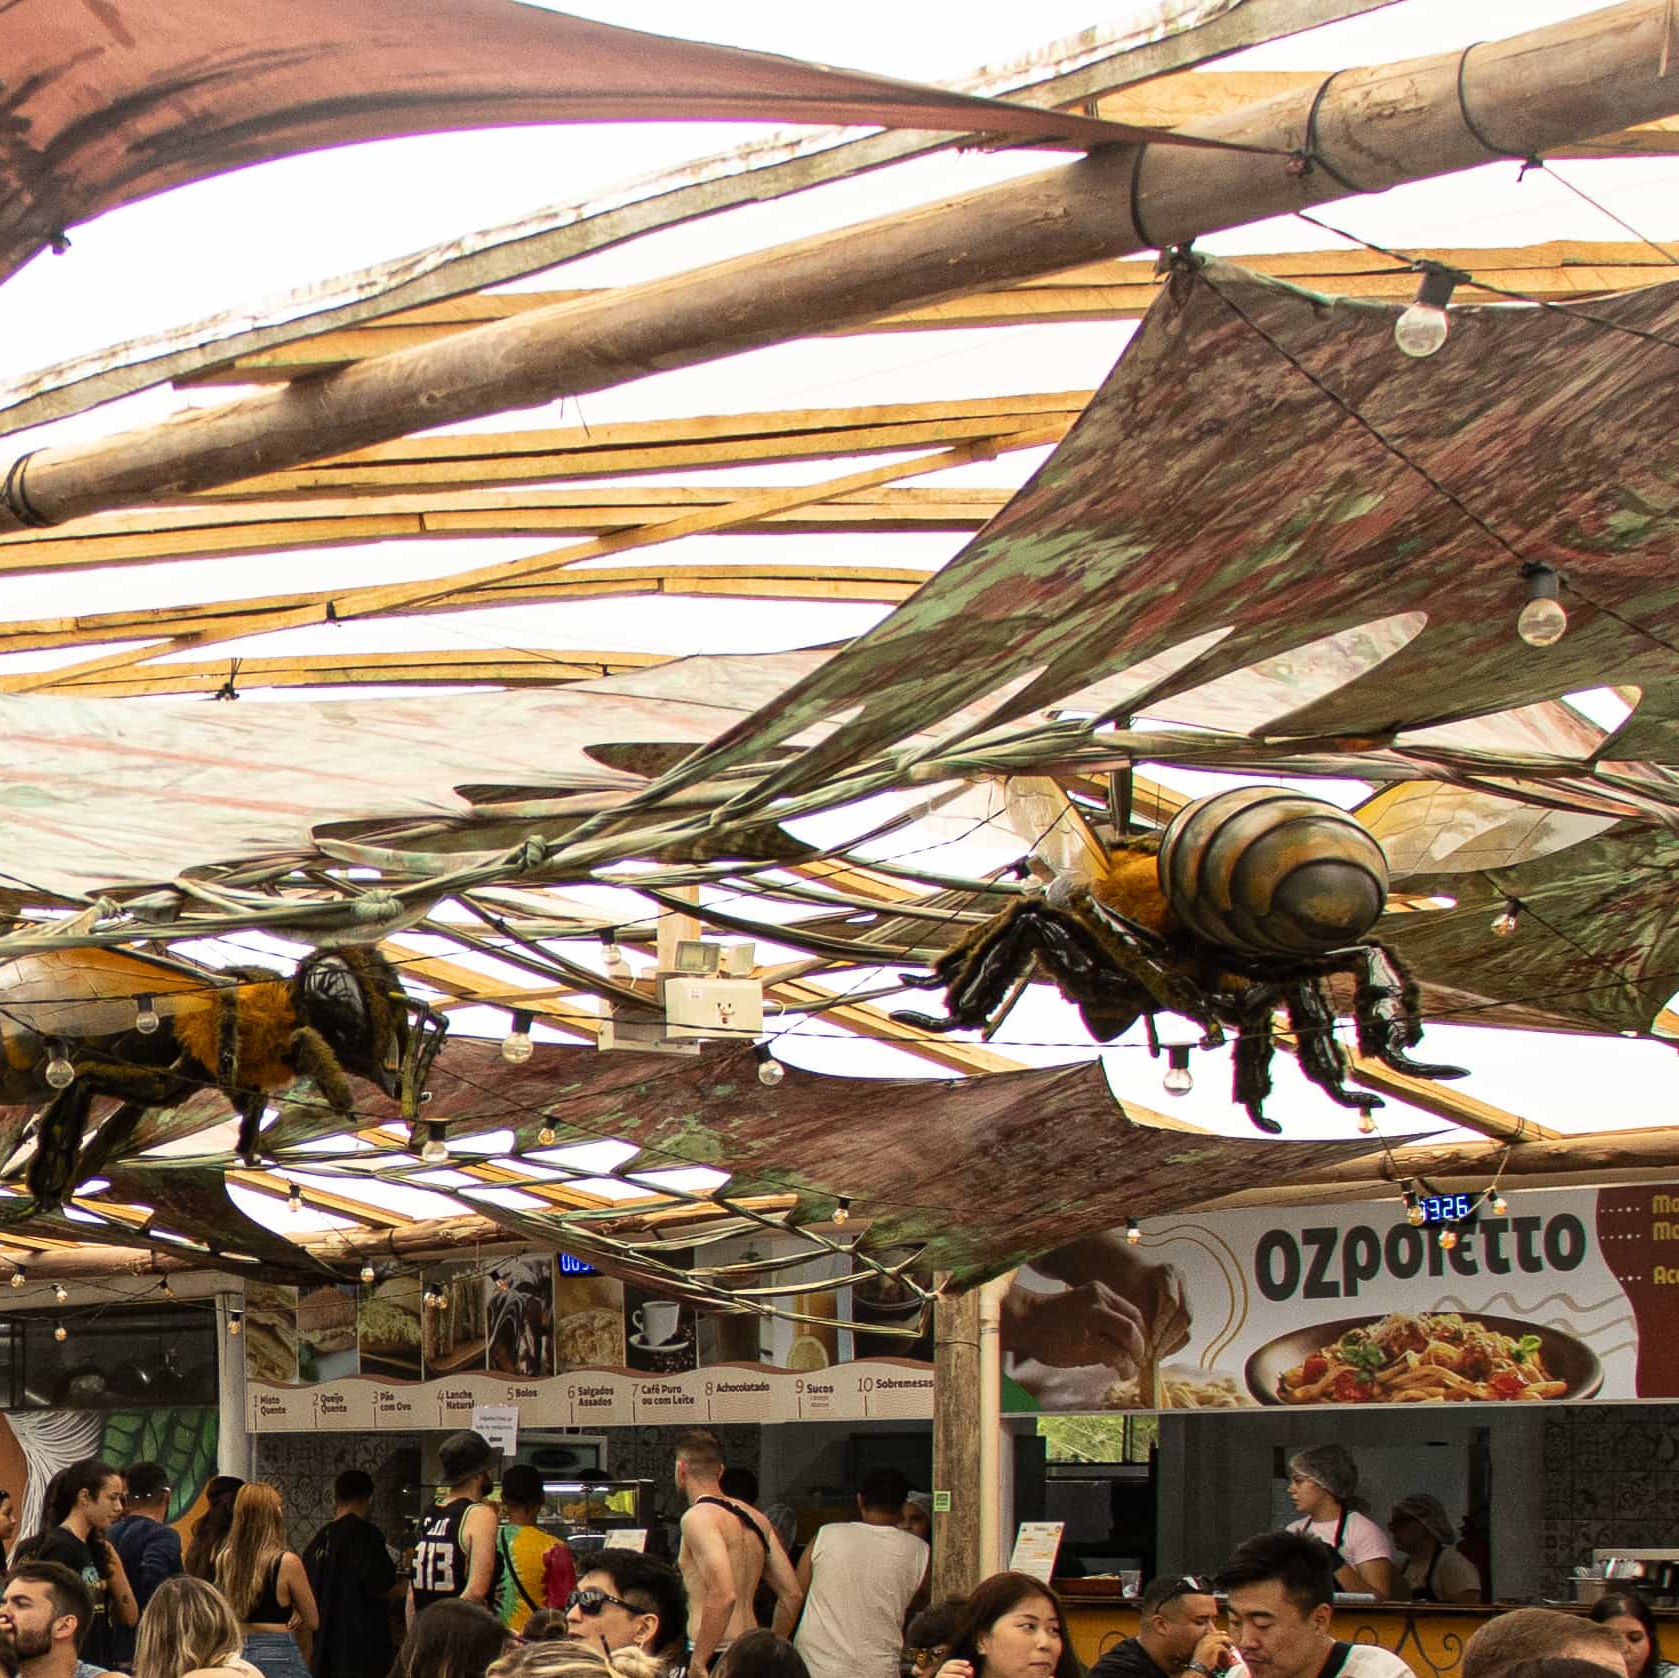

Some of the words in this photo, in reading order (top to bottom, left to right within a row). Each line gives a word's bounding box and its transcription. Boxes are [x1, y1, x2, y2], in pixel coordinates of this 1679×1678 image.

[705, 1382, 713, 1396] 8
[716, 1382, 770, 1393] Achocolatado
[795, 1379, 804, 1394] 9
[807, 1384, 834, 1394] Sucos
[857, 1377, 873, 1393] 10
[876, 1378, 934, 1389] Sobremesas
[446, 1390, 472, 1399] Lanche
[507, 1387, 514, 1401] 5
[515, 1388, 537, 1397] Bolos
[567, 1385, 575, 1399] 6
[578, 1385, 614, 1398] Salgados
[632, 1384, 639, 1398] 7
[641, 1384, 660, 1394] Café
[662, 1385, 682, 1394] Puro
[260, 1396, 280, 1405] Misto
[312, 1393, 319, 1406] 2
[320, 1393, 344, 1405] Queijo
[371, 1391, 378, 1404] 3
[380, 1391, 394, 1401] Pão
[578, 1397, 613, 1407] Assados
[642, 1397, 652, 1405] ou
[654, 1396, 671, 1405] com
[673, 1395, 694, 1405] Leite
[321, 1404, 347, 1413] Quente
[380, 1404, 395, 1412] com
[397, 1403, 411, 1411] Ovo
[446, 1400, 475, 1410] Natural
[260, 1406, 286, 1416] Quente
